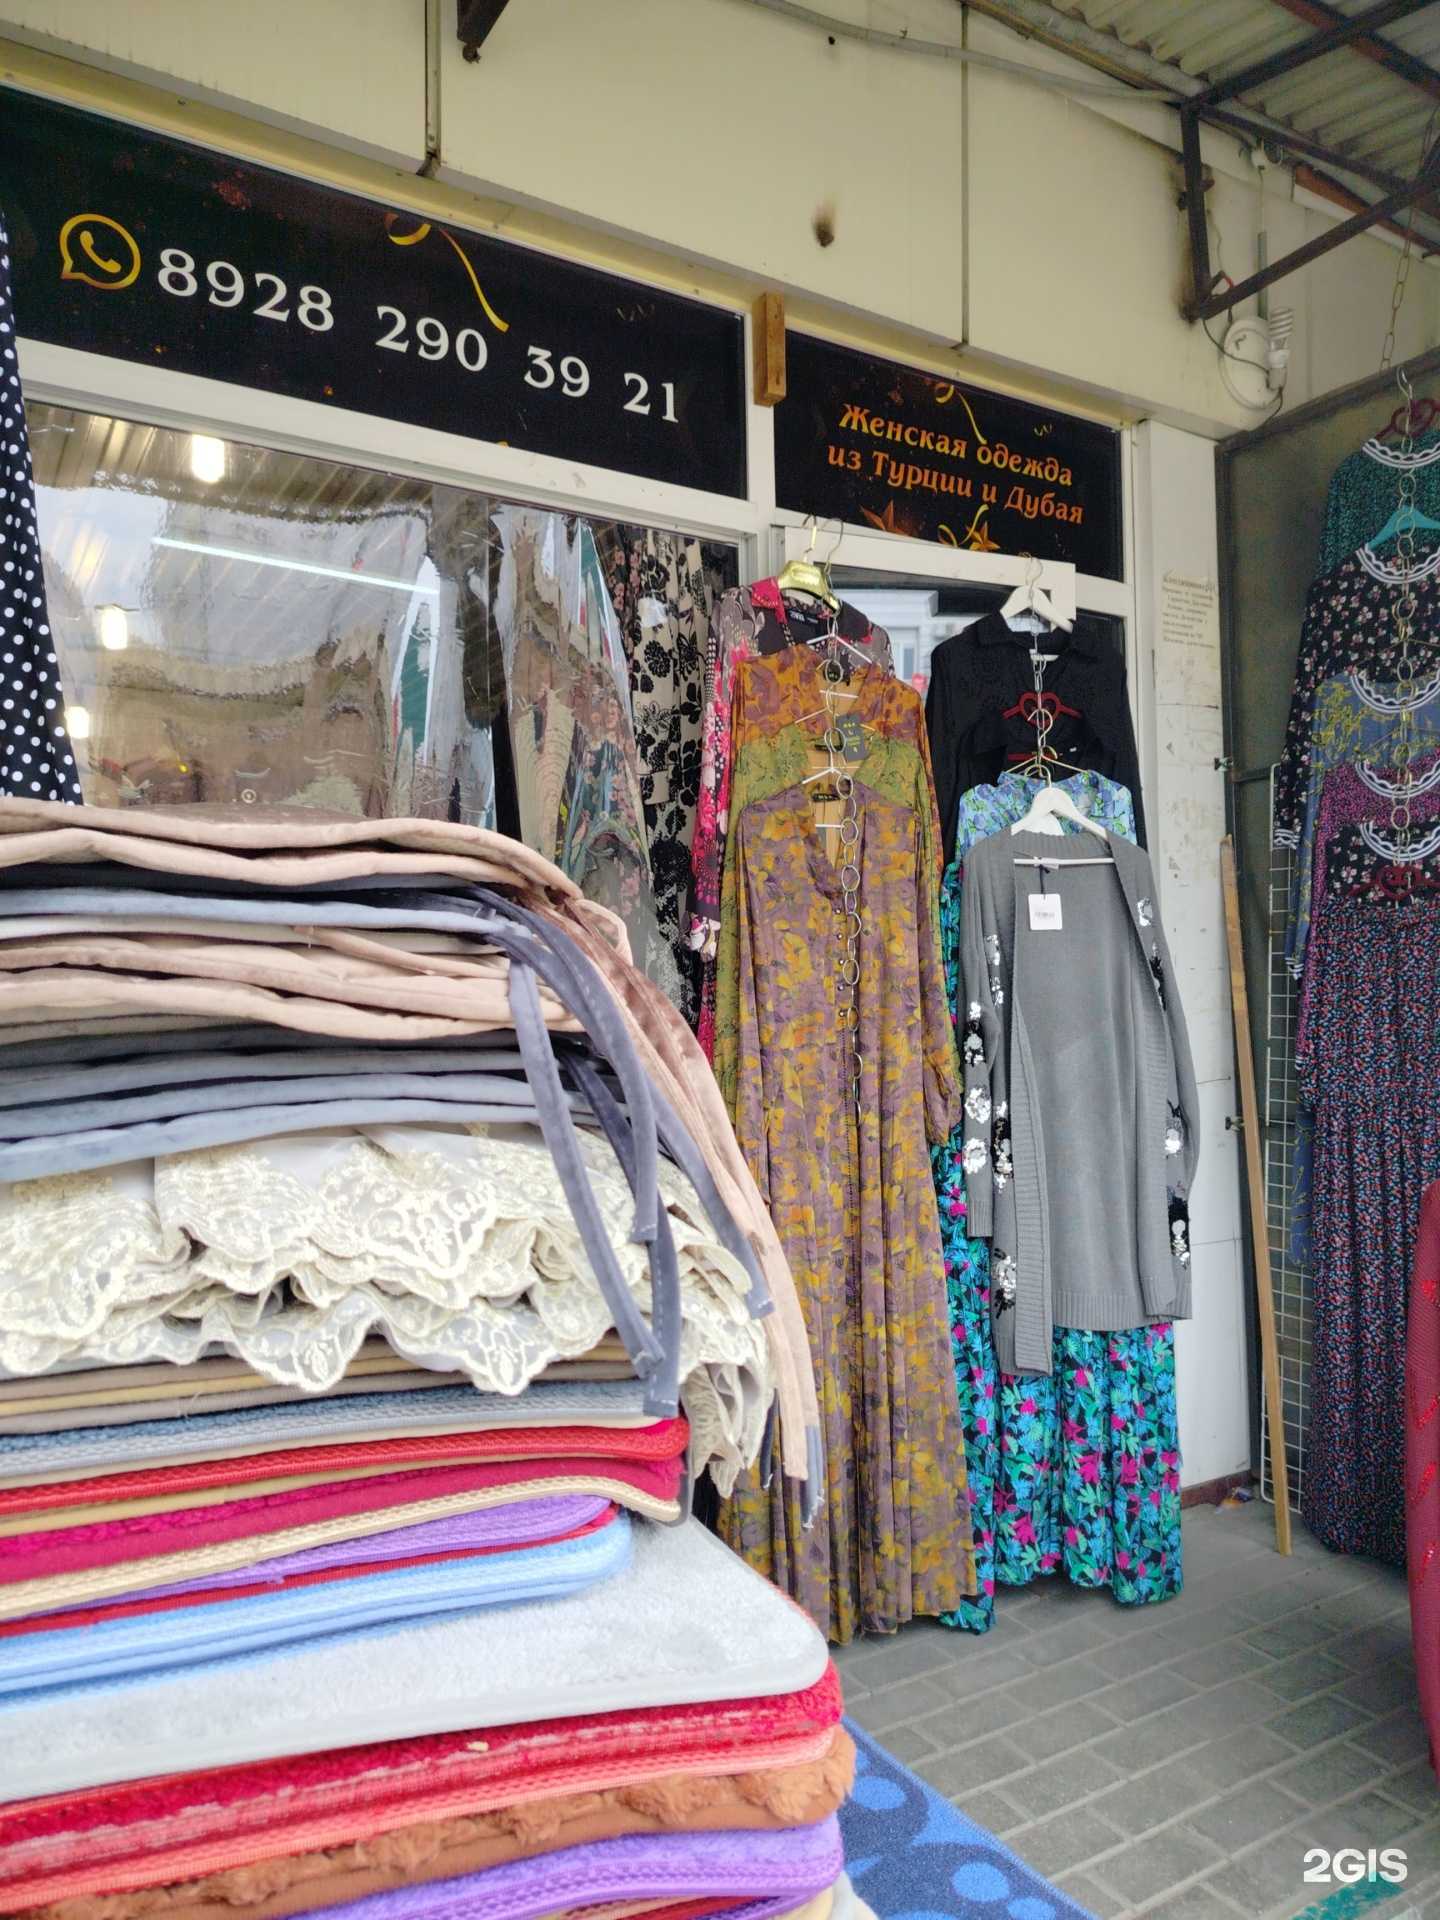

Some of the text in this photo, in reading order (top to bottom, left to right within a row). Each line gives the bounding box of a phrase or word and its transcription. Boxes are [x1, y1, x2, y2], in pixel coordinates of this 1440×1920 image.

[158, 249, 679, 424] 8928 290 39 21
[828, 445, 1083, 524] из Турции и Дубая
[839, 404, 1072, 486] Женская одежда
